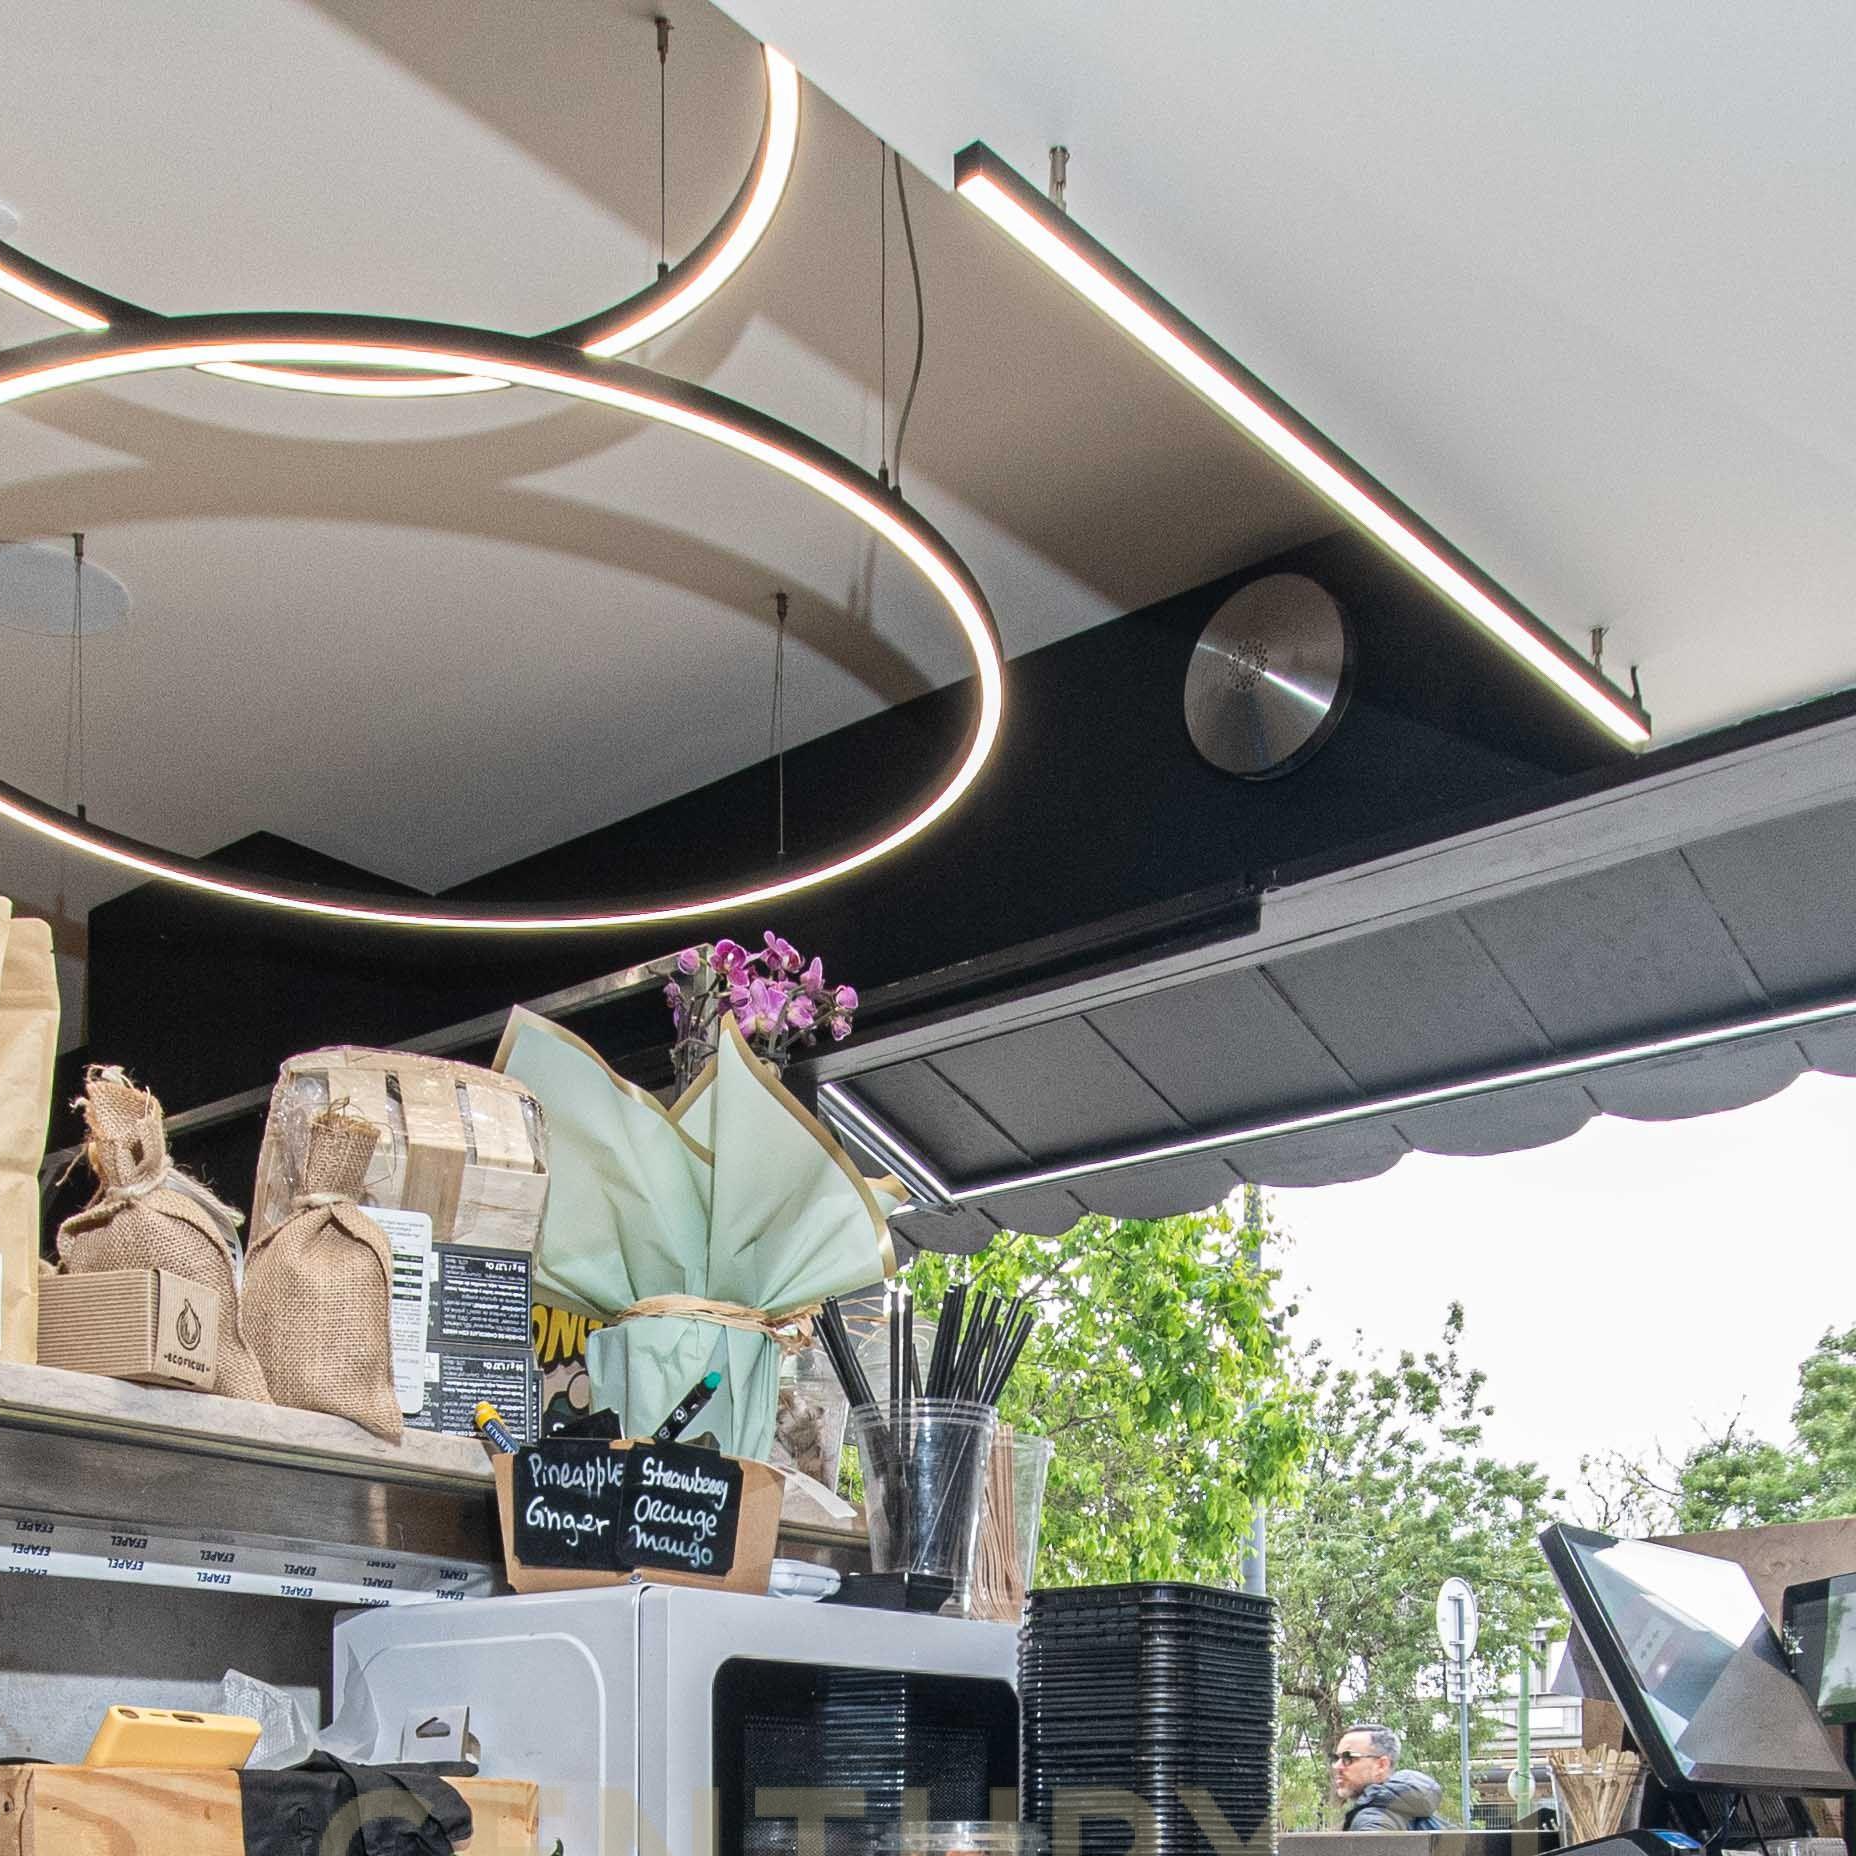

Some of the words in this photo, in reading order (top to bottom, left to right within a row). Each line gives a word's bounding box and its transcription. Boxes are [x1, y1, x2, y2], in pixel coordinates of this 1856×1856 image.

[641, 1456, 729, 1511] Strawberry
[526, 1496, 610, 1547] Ginger
[110, 1535, 148, 1549] EFAPEL
[11, 1542, 52, 1556] EFAPEL
[199, 1550, 235, 1563] EFAPEL
[107, 1558, 144, 1571] EFAPEL
[284, 1563, 316, 1576] EFAPEL
[196, 1572, 232, 1585] EFAPEL
[362, 1576, 392, 1589] EFAPEL
[280, 1585, 313, 1598] EFAPEL
